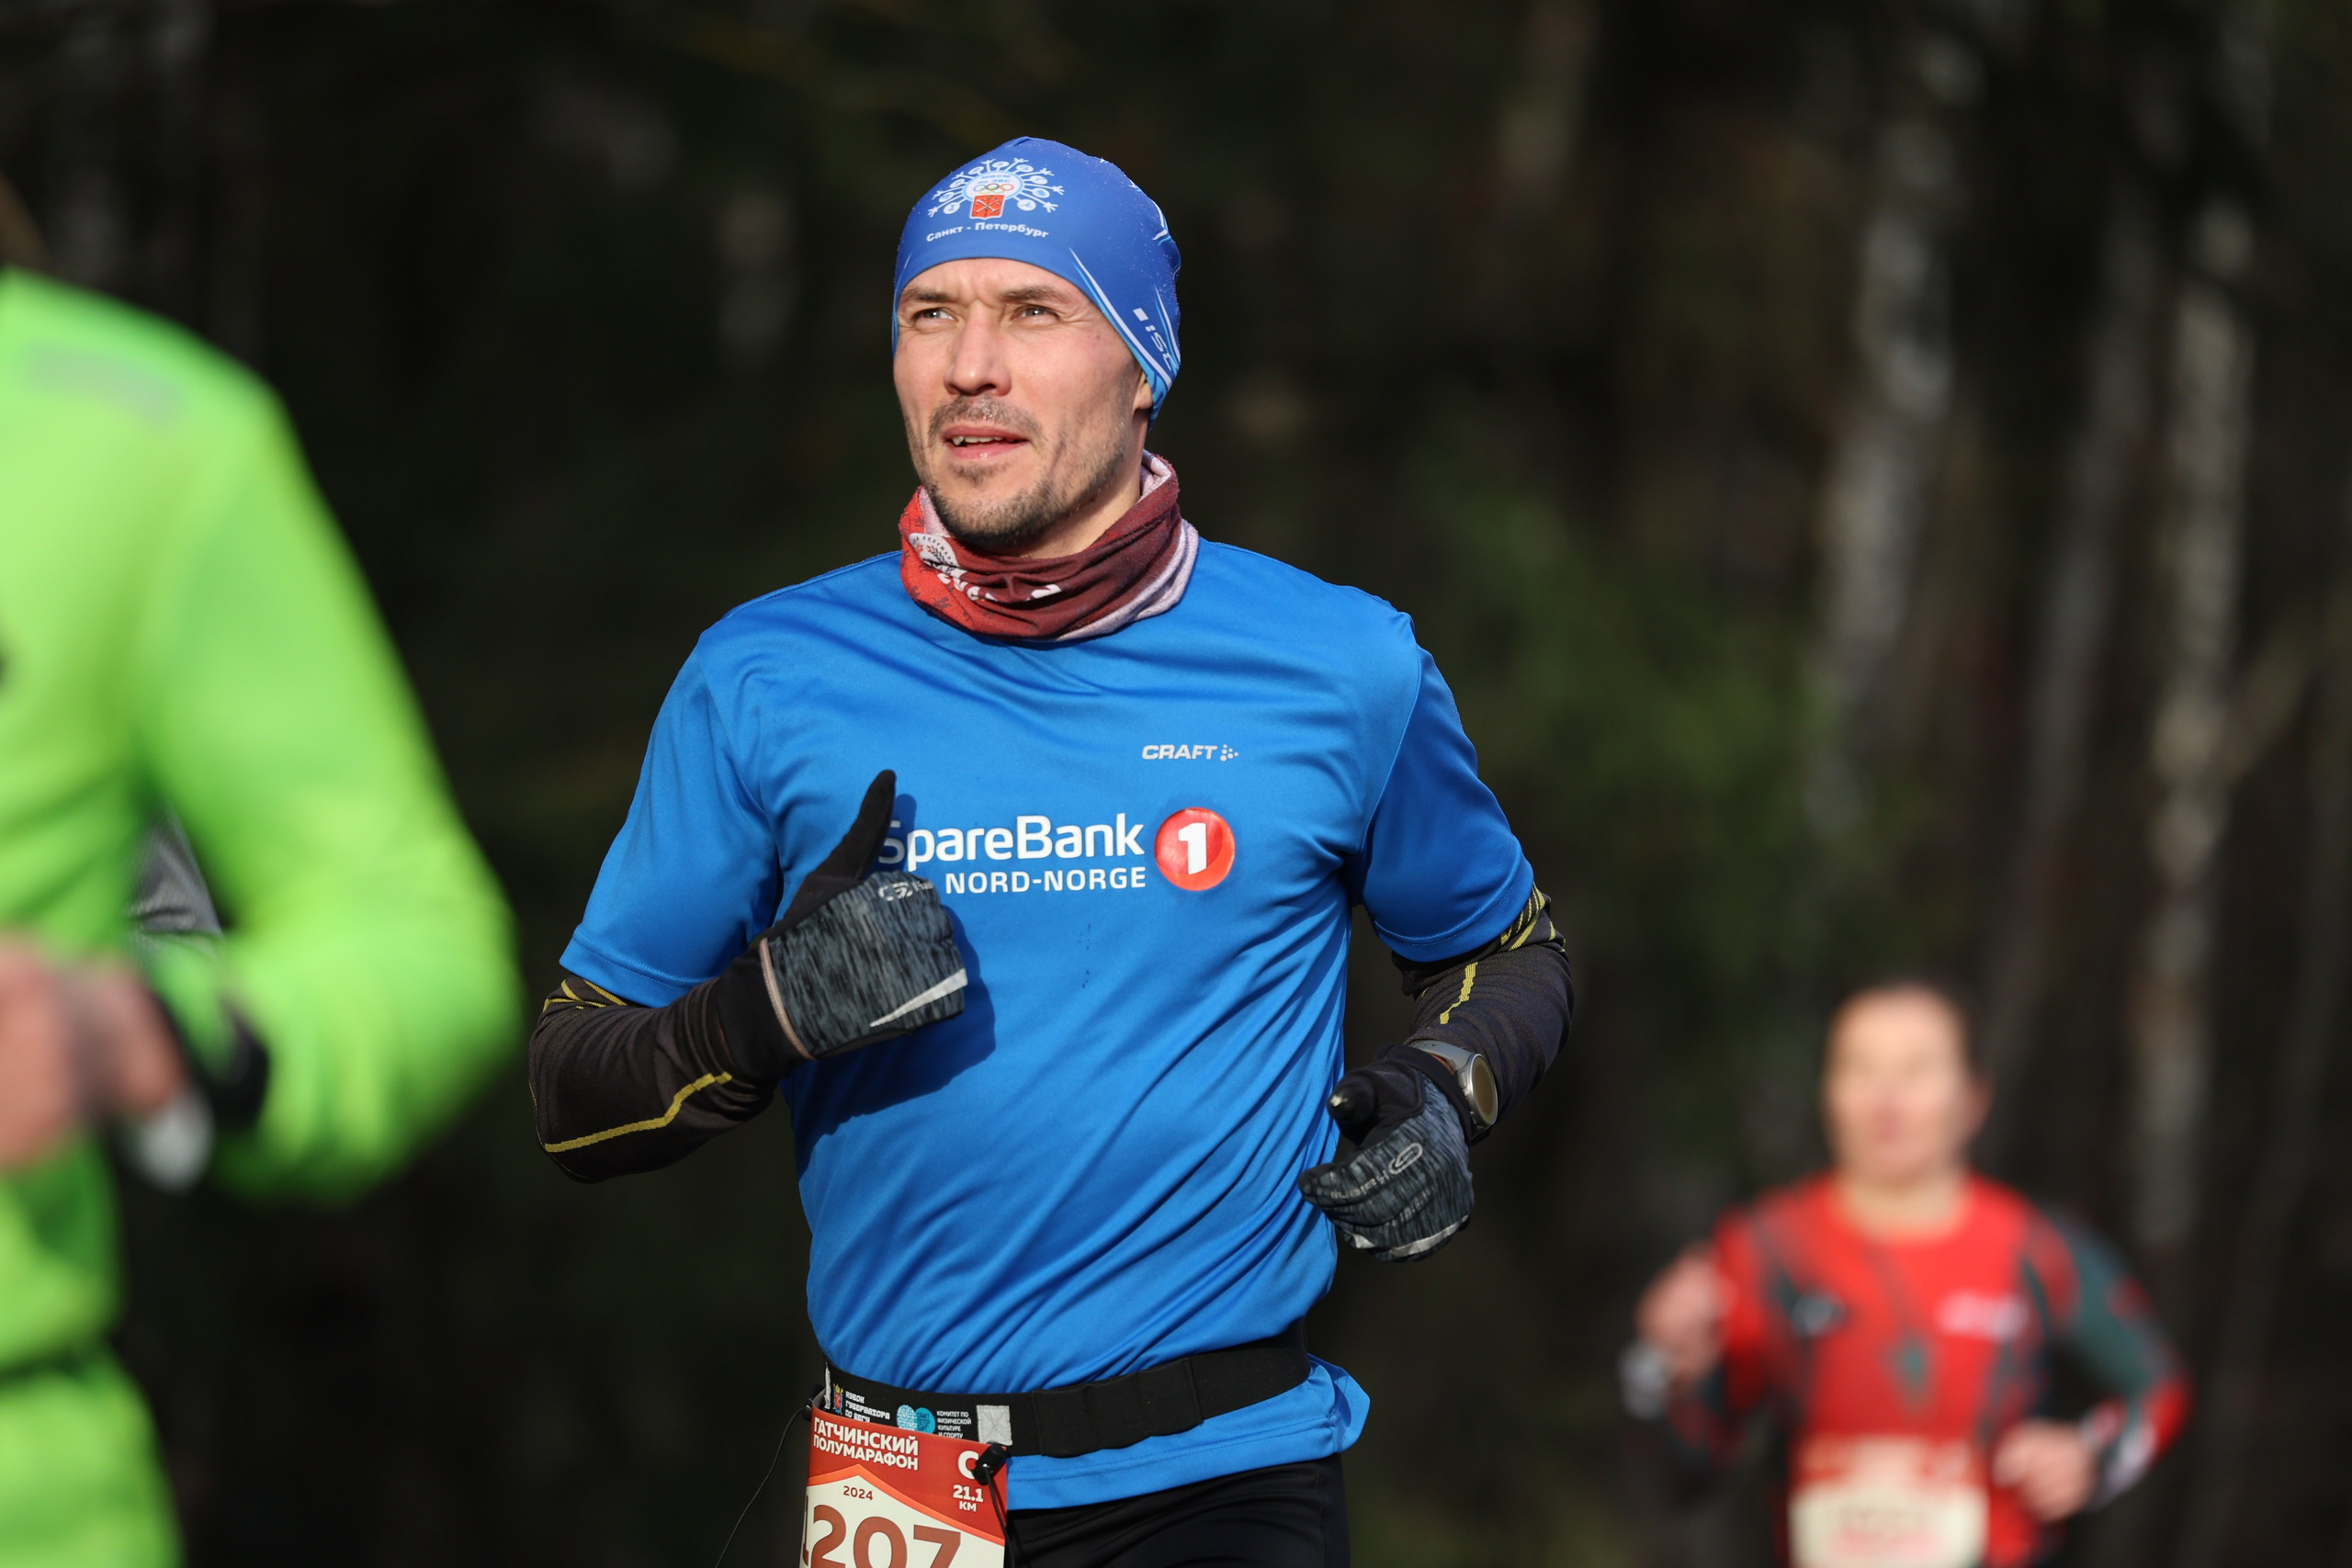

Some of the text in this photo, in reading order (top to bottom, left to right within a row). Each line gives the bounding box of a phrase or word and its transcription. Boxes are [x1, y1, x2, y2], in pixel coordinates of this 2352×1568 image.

[926, 226, 964, 242] Санкт
[975, 221, 1049, 238] Петербург
[1141, 744, 1217, 761] CRAFT
[1177, 821, 1208, 875] 1
[944, 866, 1147, 895] NORD-NORGE
[937, 1416, 972, 1425] ФИЗИЧЕСКОЙ
[813, 1416, 919, 1456] ГАТЧИНСКИЙ
[813, 1436, 919, 1471] ПОЛУМАРАФОН
[842, 1485, 874, 1501] 2024
[953, 1484, 984, 1503] 21.1
[958, 1501, 977, 1512] КМ
